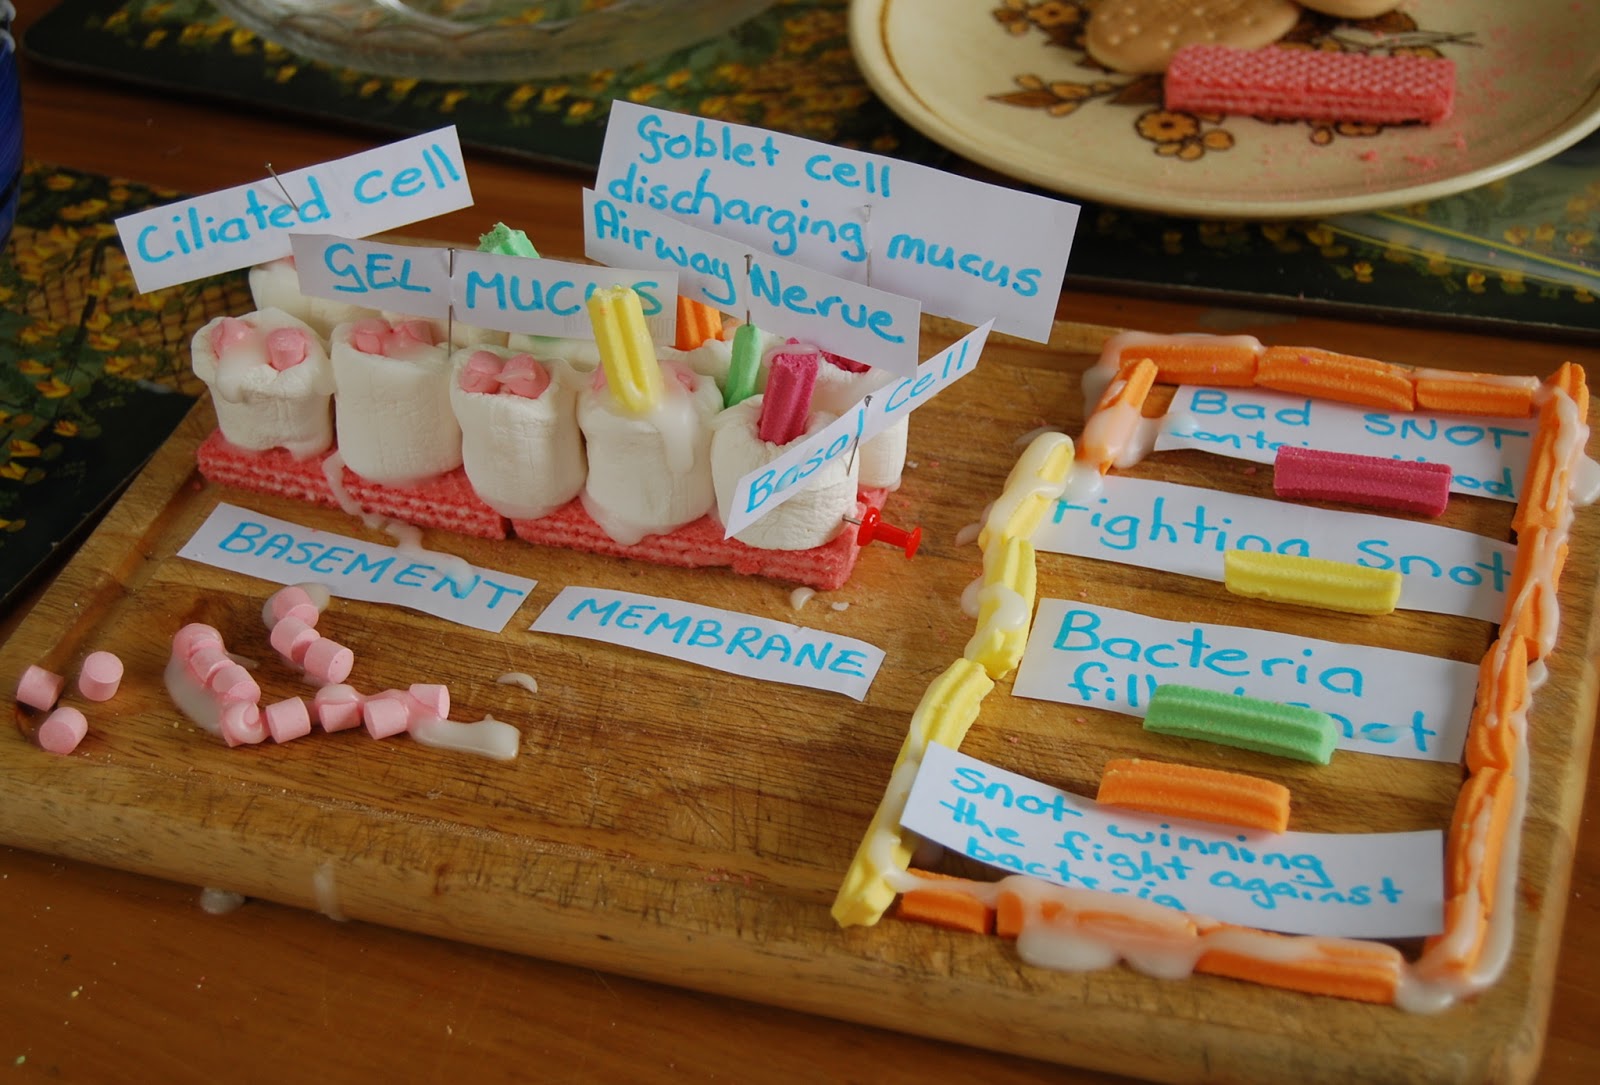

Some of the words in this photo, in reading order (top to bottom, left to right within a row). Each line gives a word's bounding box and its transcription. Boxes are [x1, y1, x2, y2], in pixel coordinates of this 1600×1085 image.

[636, 113, 781, 168] Goblet
[136, 175, 332, 264] Ciliated
[607, 161, 868, 264] discharging
[886, 233, 1043, 298] mucus
[323, 242, 432, 294] GEL
[593, 199, 738, 307] Airway
[747, 263, 906, 344] Nerve
[745, 408, 865, 514] Basal
[1189, 389, 1312, 427] Bad
[1363, 413, 1530, 449] SNOT
[217, 521, 525, 610] BASEMENT
[566, 597, 868, 679] MEMBRANE
[1052, 609, 1365, 698] Bacteria
[1286, 701, 1438, 753] not
[938, 796, 1026, 848] the
[1055, 829, 1195, 882] fight
[1208, 869, 1405, 911] against
[965, 836, 1188, 912] bacteia
[1106, 822, 1336, 890] winning
